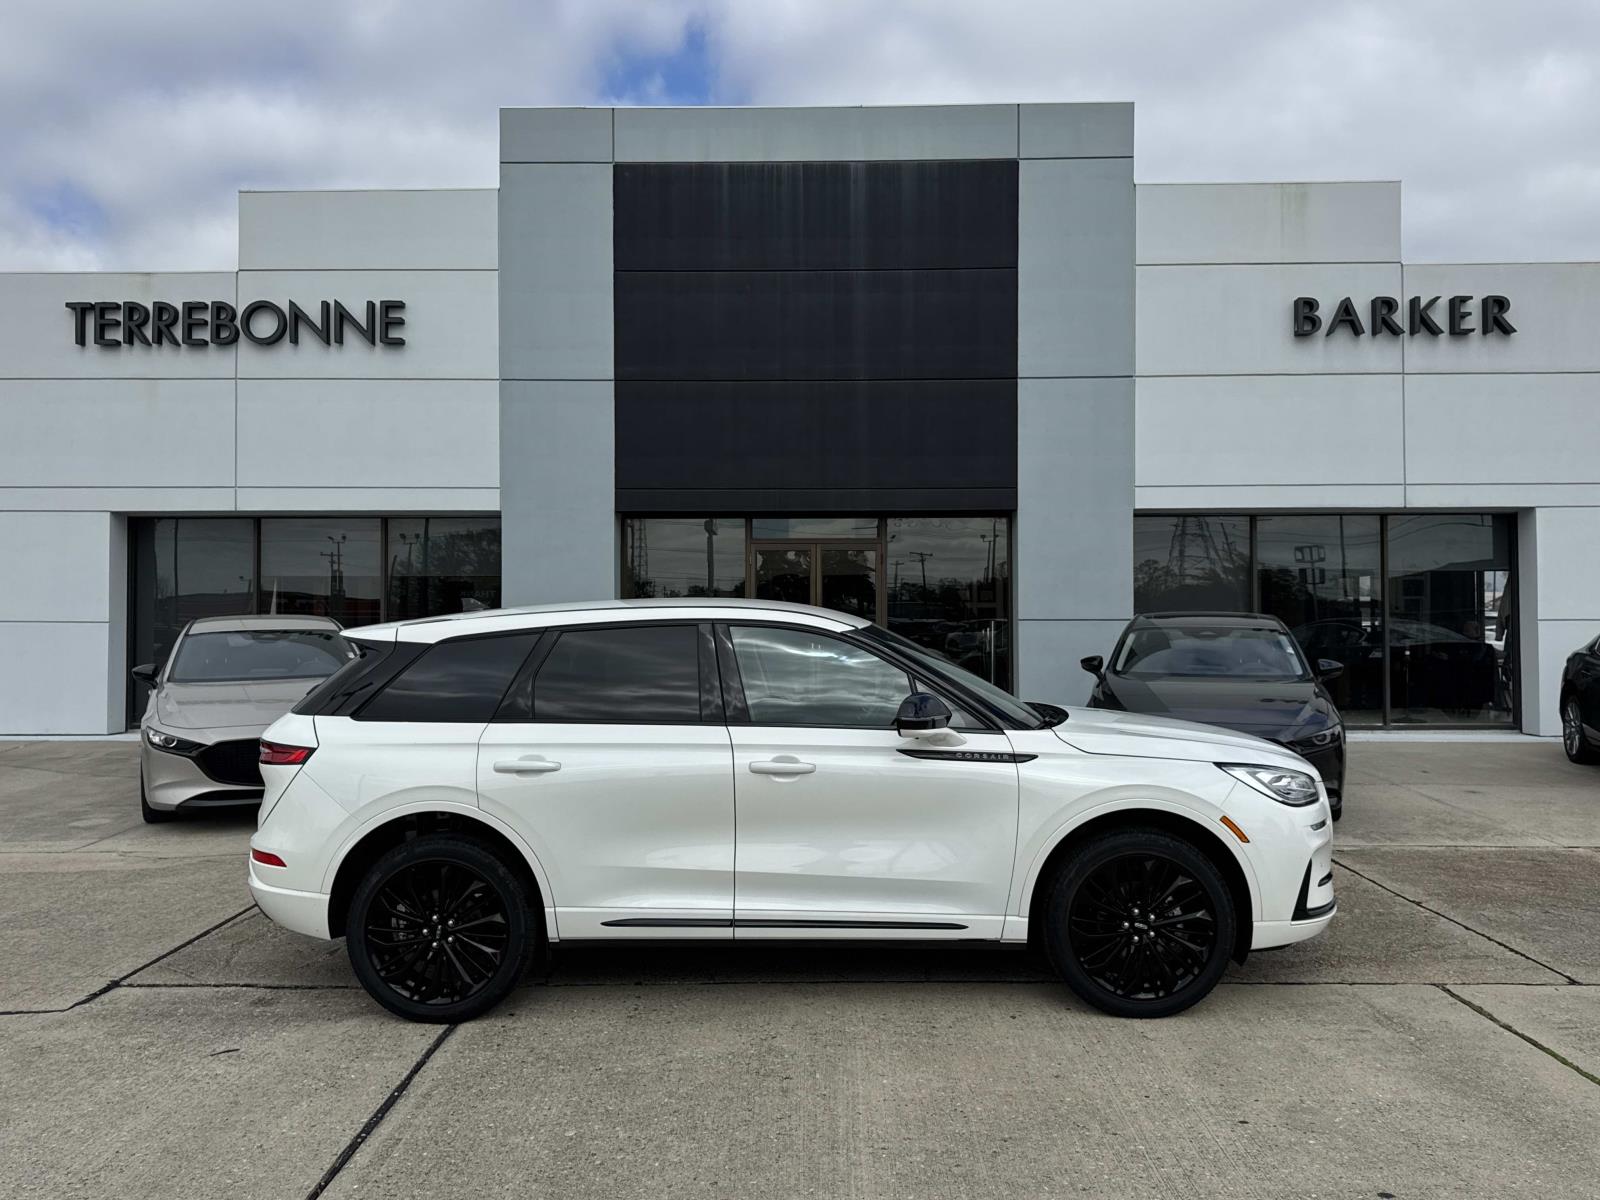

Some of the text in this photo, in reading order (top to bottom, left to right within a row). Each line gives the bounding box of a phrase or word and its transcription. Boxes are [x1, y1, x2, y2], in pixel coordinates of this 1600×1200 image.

[65, 299, 406, 347] TERREBONNE
[1293, 295, 1518, 337] BARKER
[955, 752, 1010, 760] CORSAIR
